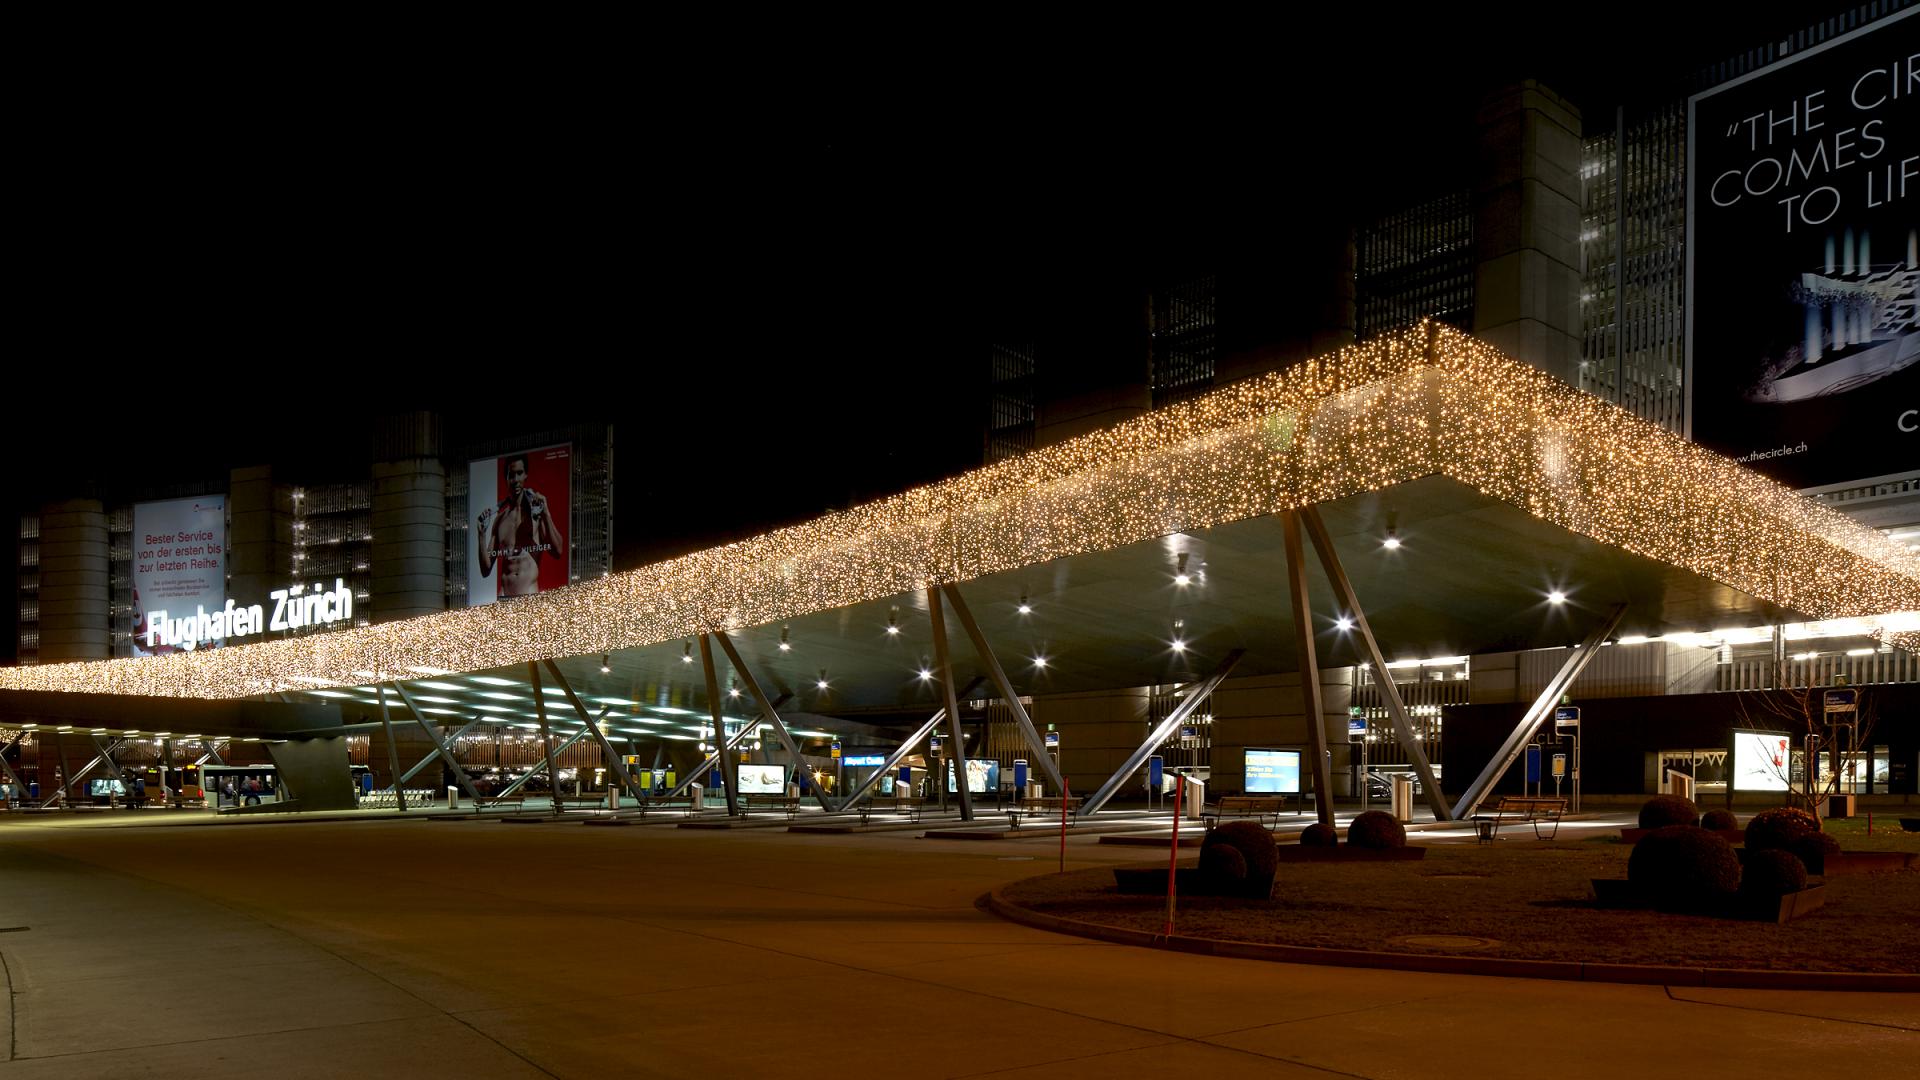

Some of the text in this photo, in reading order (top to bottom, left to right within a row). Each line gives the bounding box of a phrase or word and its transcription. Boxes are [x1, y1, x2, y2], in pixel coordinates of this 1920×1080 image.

[1711, 119, 1886, 207] COMES
[1778, 155, 1920, 233] TO LIF
[138, 543, 222, 560] von der ersten bis
[145, 530, 214, 545] Bester Service
[139, 558, 220, 573] zur letzten Reihe.
[146, 577, 352, 652] Flughafen Zürich
